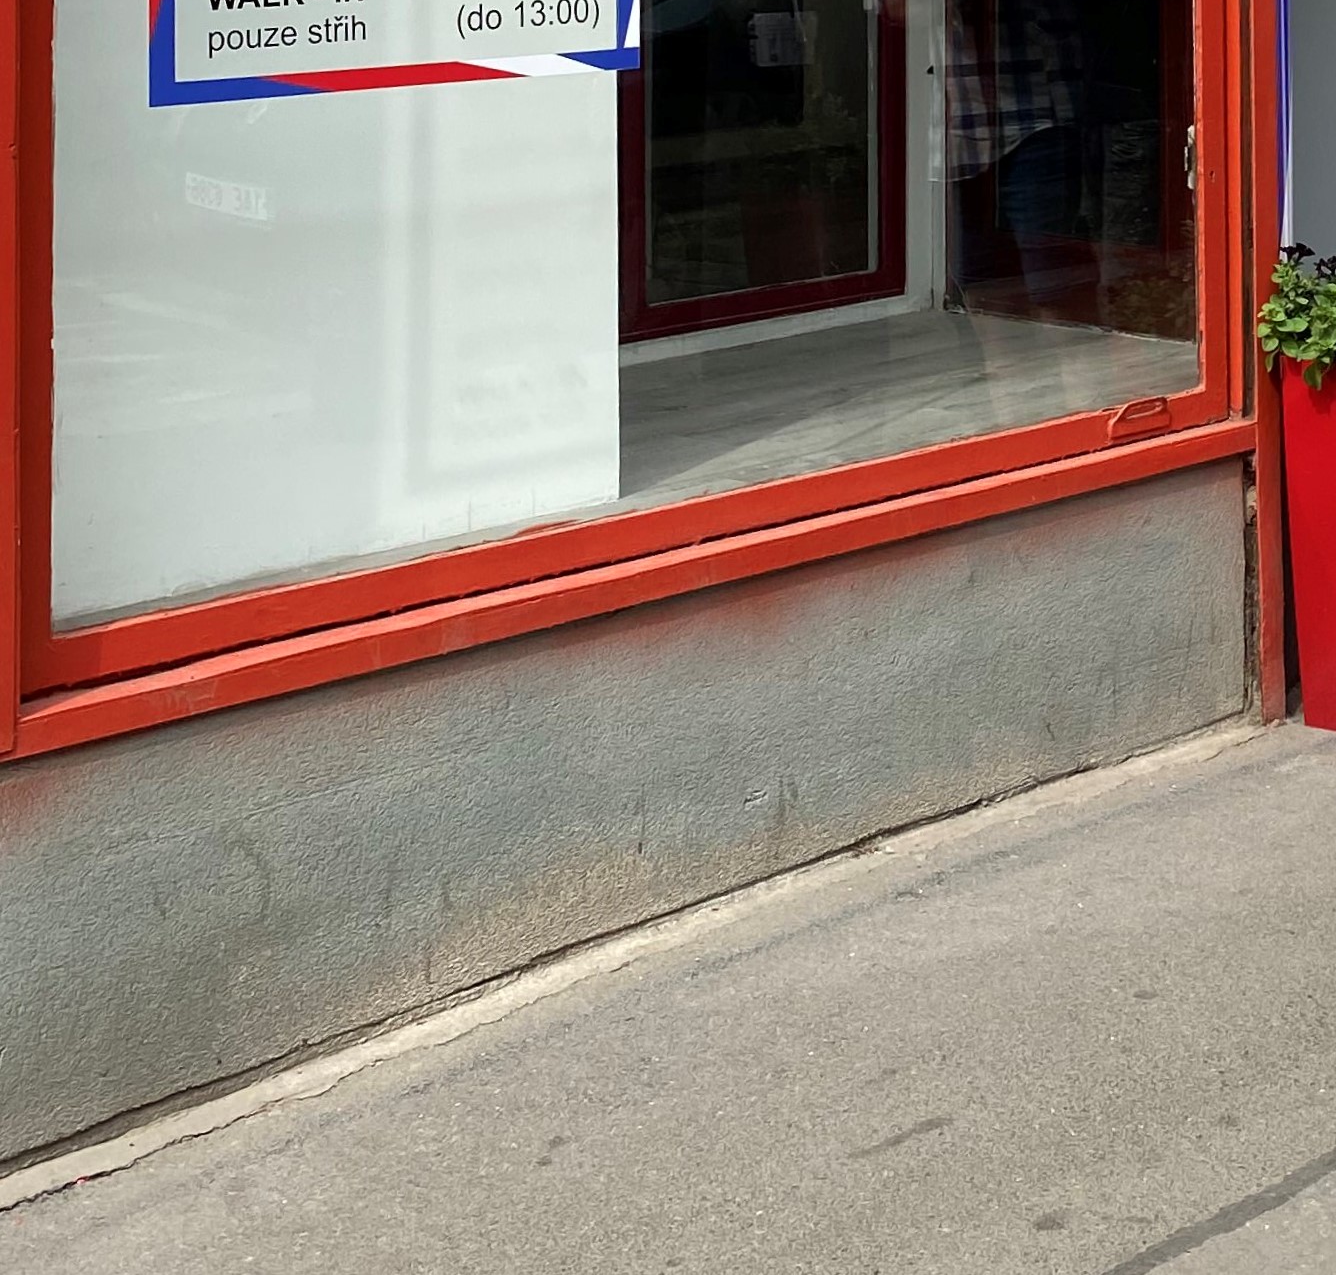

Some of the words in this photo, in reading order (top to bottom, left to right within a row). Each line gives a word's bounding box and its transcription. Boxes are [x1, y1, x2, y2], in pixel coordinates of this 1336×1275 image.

[208, 24, 297, 58] pouze
[307, 14, 367, 44] střih
[456, 4, 502, 39] (do
